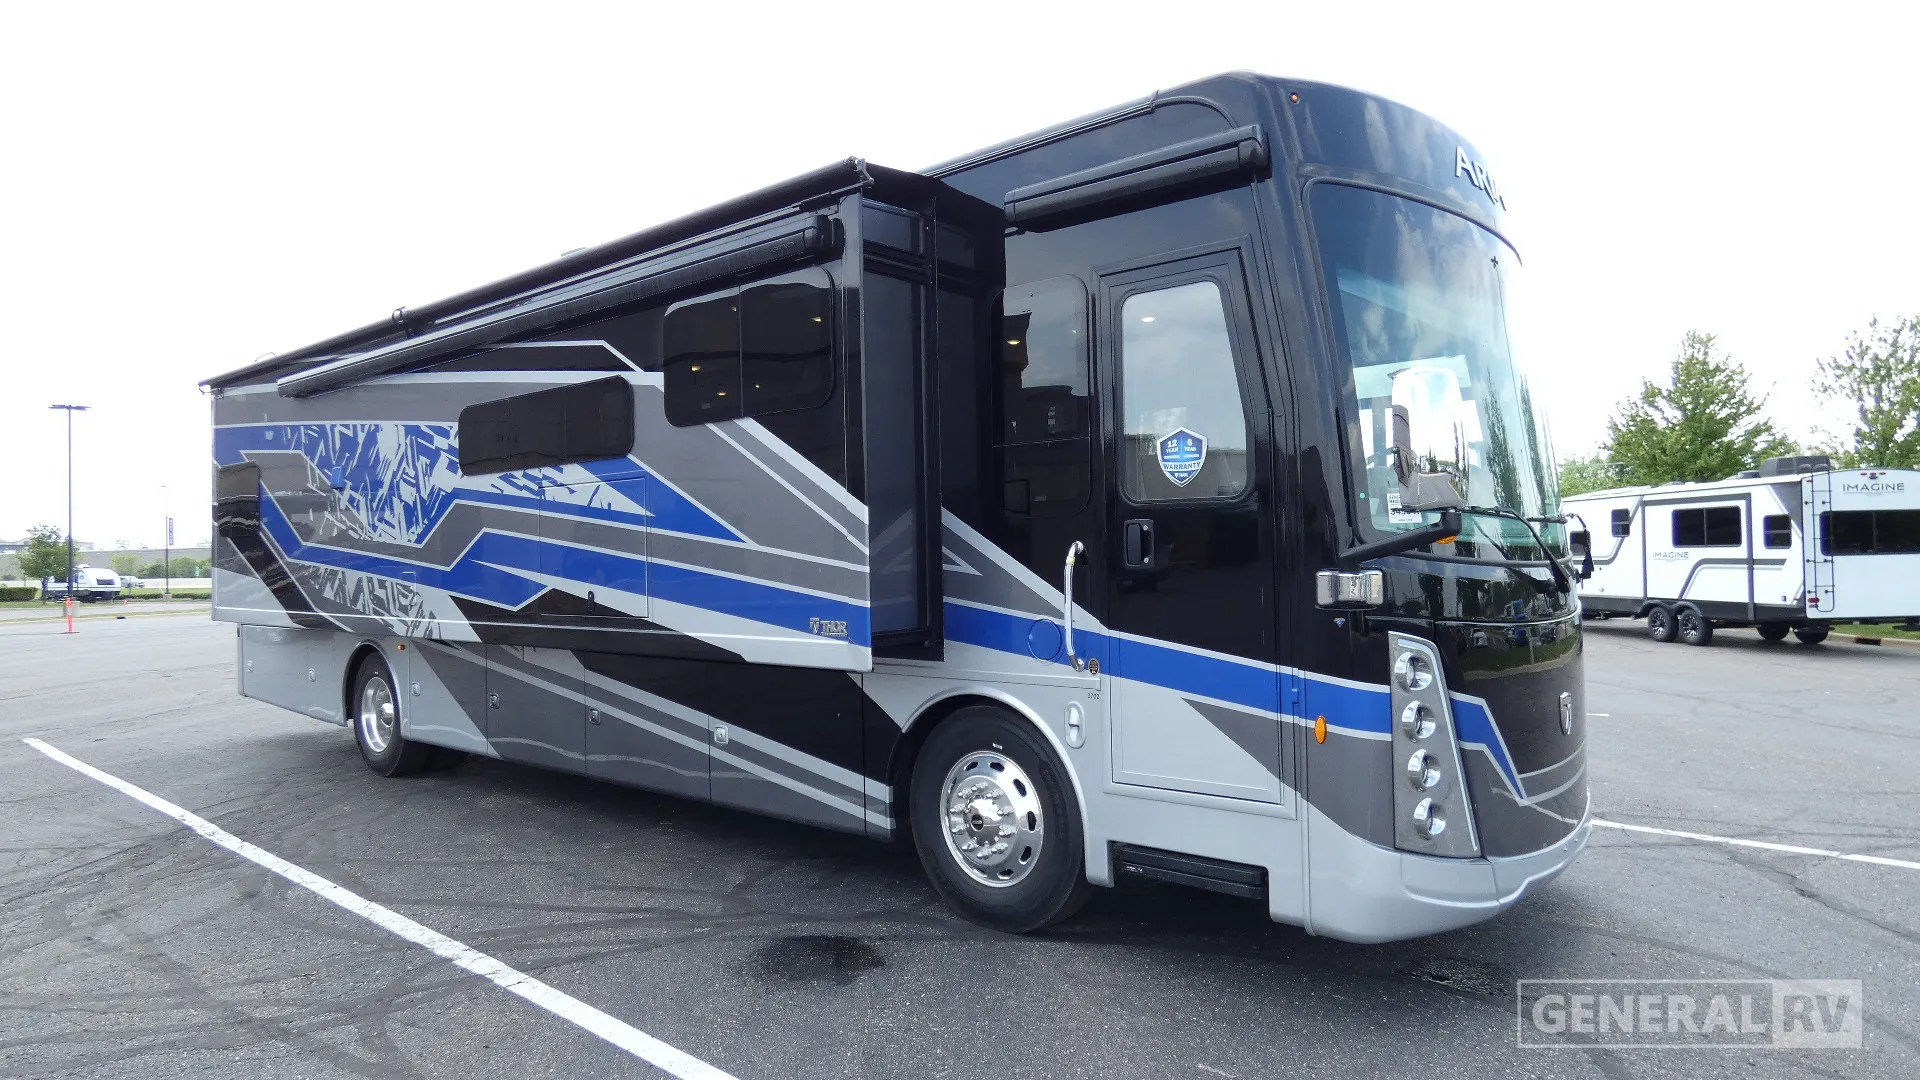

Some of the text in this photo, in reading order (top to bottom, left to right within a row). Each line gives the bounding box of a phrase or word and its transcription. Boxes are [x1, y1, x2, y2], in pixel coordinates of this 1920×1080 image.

[1167, 439, 1178, 448] 12
[1187, 438, 1193, 447] 6
[1163, 462, 1201, 470] WARRANTY
[1842, 482, 1905, 492] IMAGINE
[1652, 551, 1689, 559] IMAGINE
[820, 620, 848, 634] THOR
